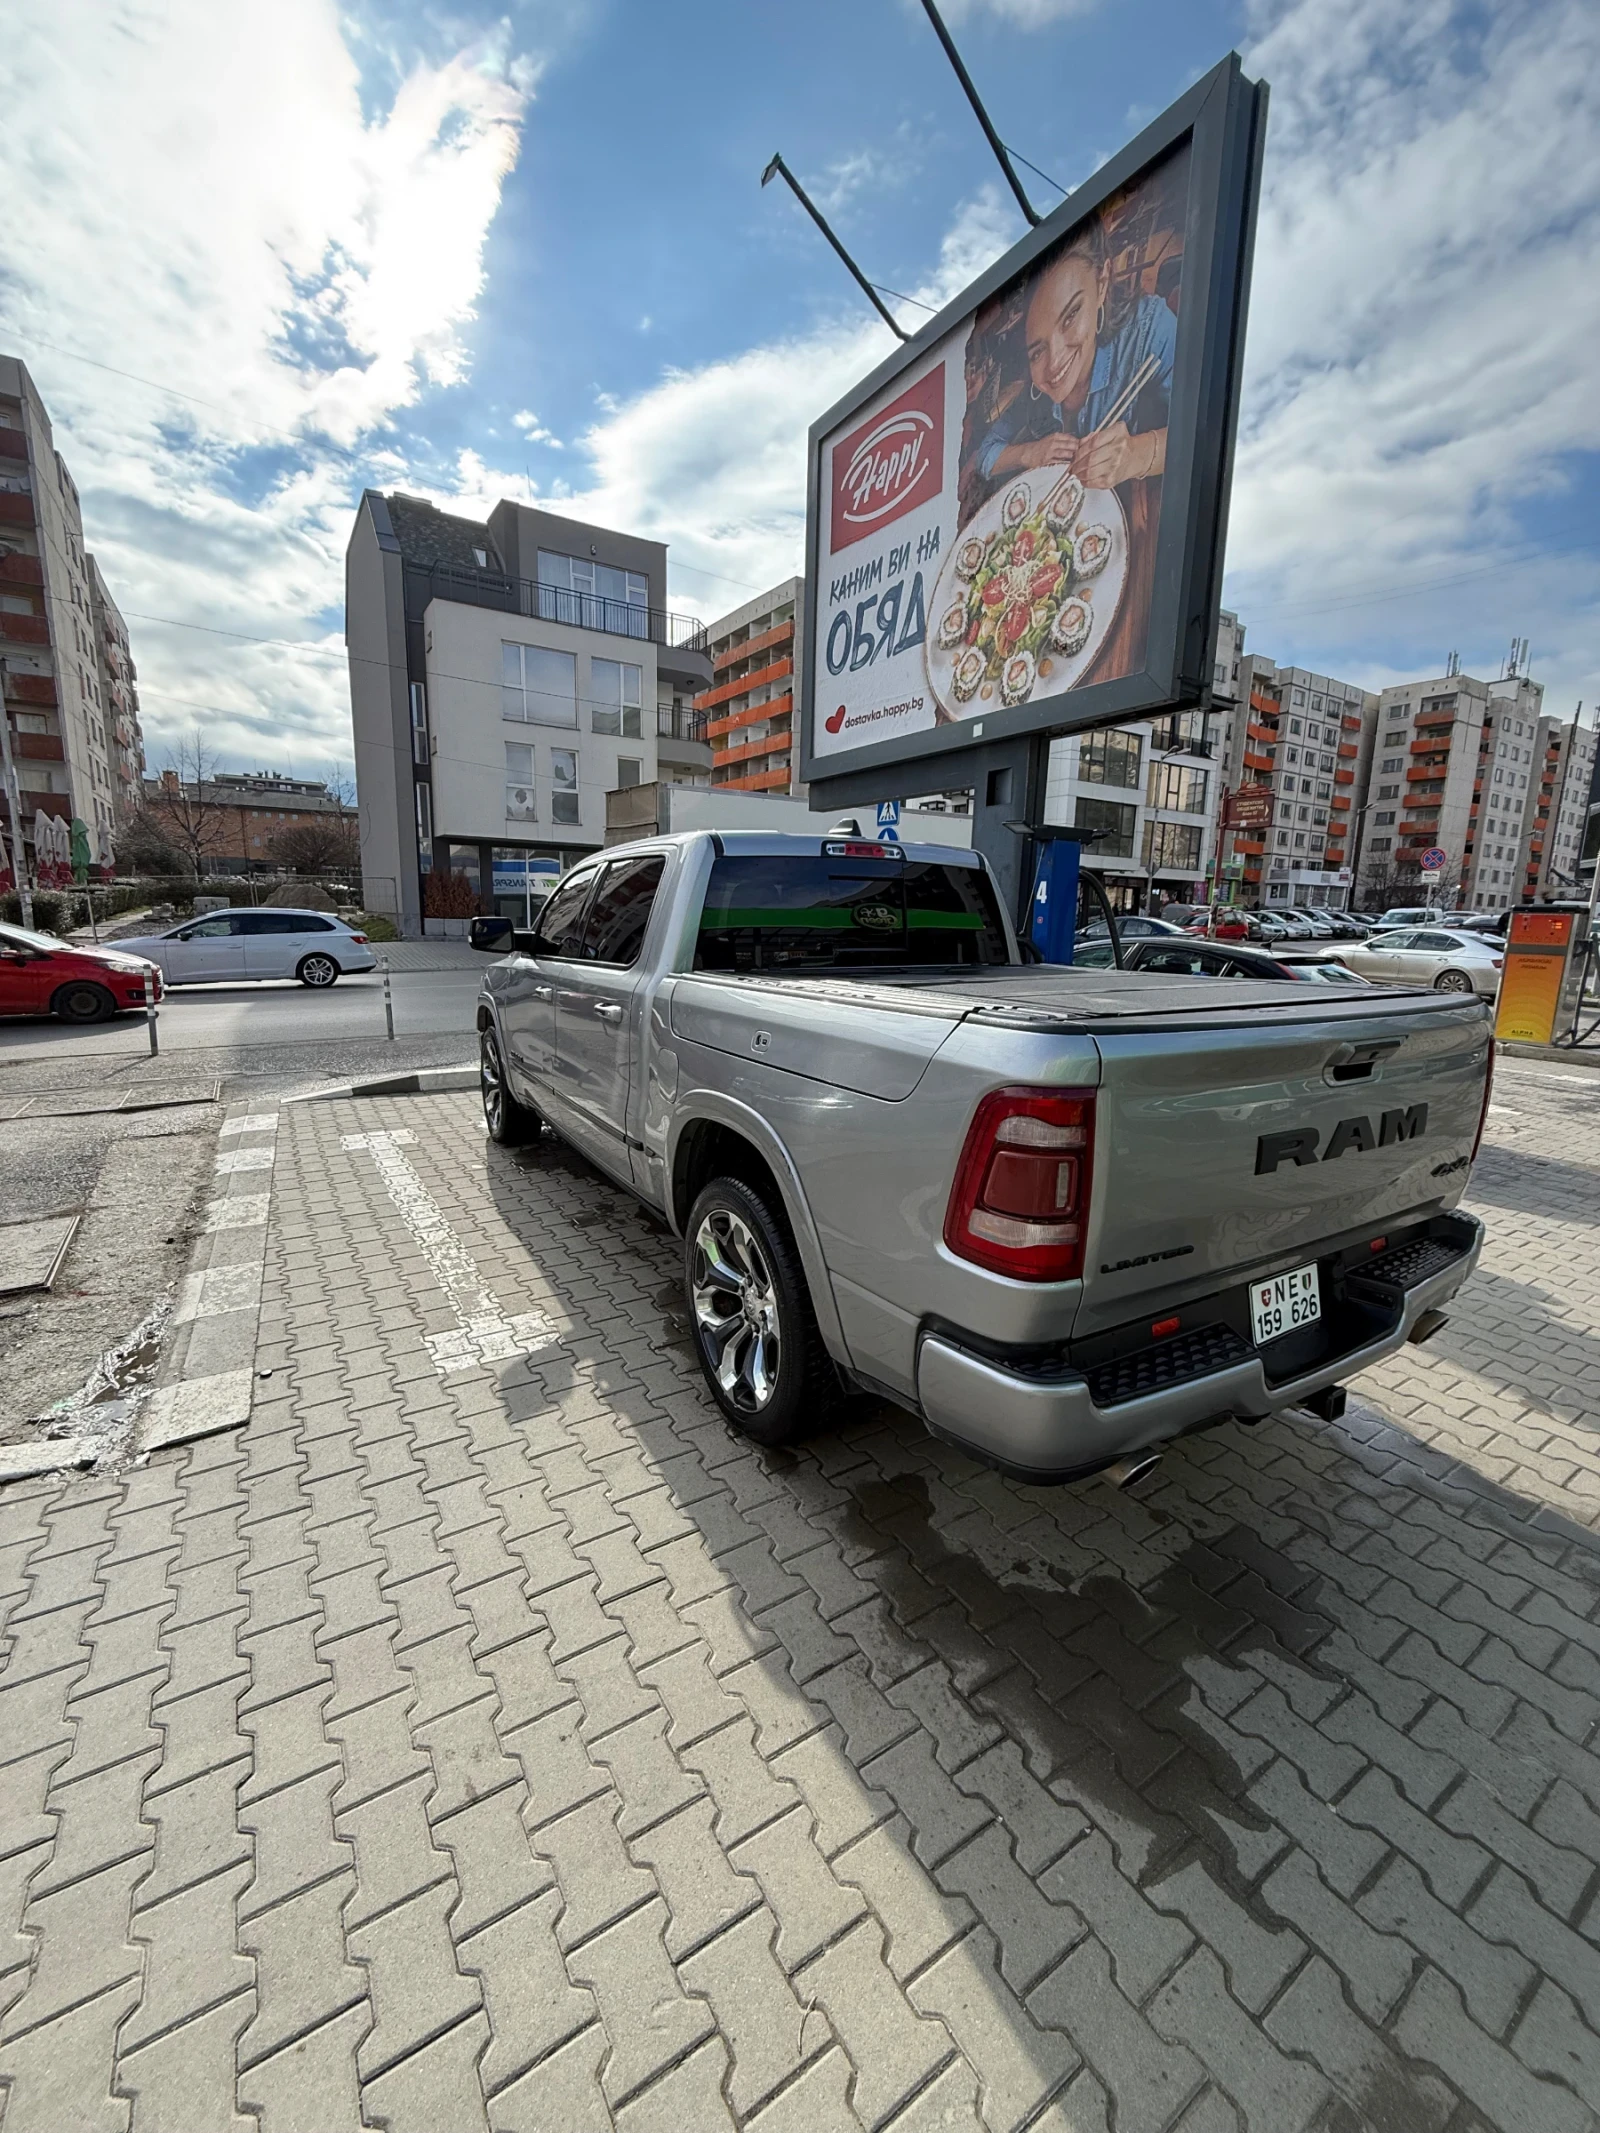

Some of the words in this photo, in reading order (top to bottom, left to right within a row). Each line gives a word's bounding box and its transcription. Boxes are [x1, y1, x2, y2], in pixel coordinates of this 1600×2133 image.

[848, 431, 925, 512] Happy
[829, 555, 884, 607] КАНИМ
[887, 540, 911, 576] ВИ
[916, 525, 941, 565] НА
[826, 570, 926, 676] ОБЯД
[844, 696, 925, 729] dostavka.happy.bg
[1035, 880, 1048, 904] 4
[1254, 1102, 1429, 1176] RAM
[1100, 1244, 1195, 1275] LIMITED
[1274, 1273, 1299, 1305] NE
[1257, 1307, 1283, 1340] 159
[1291, 1293, 1319, 1325] 626
